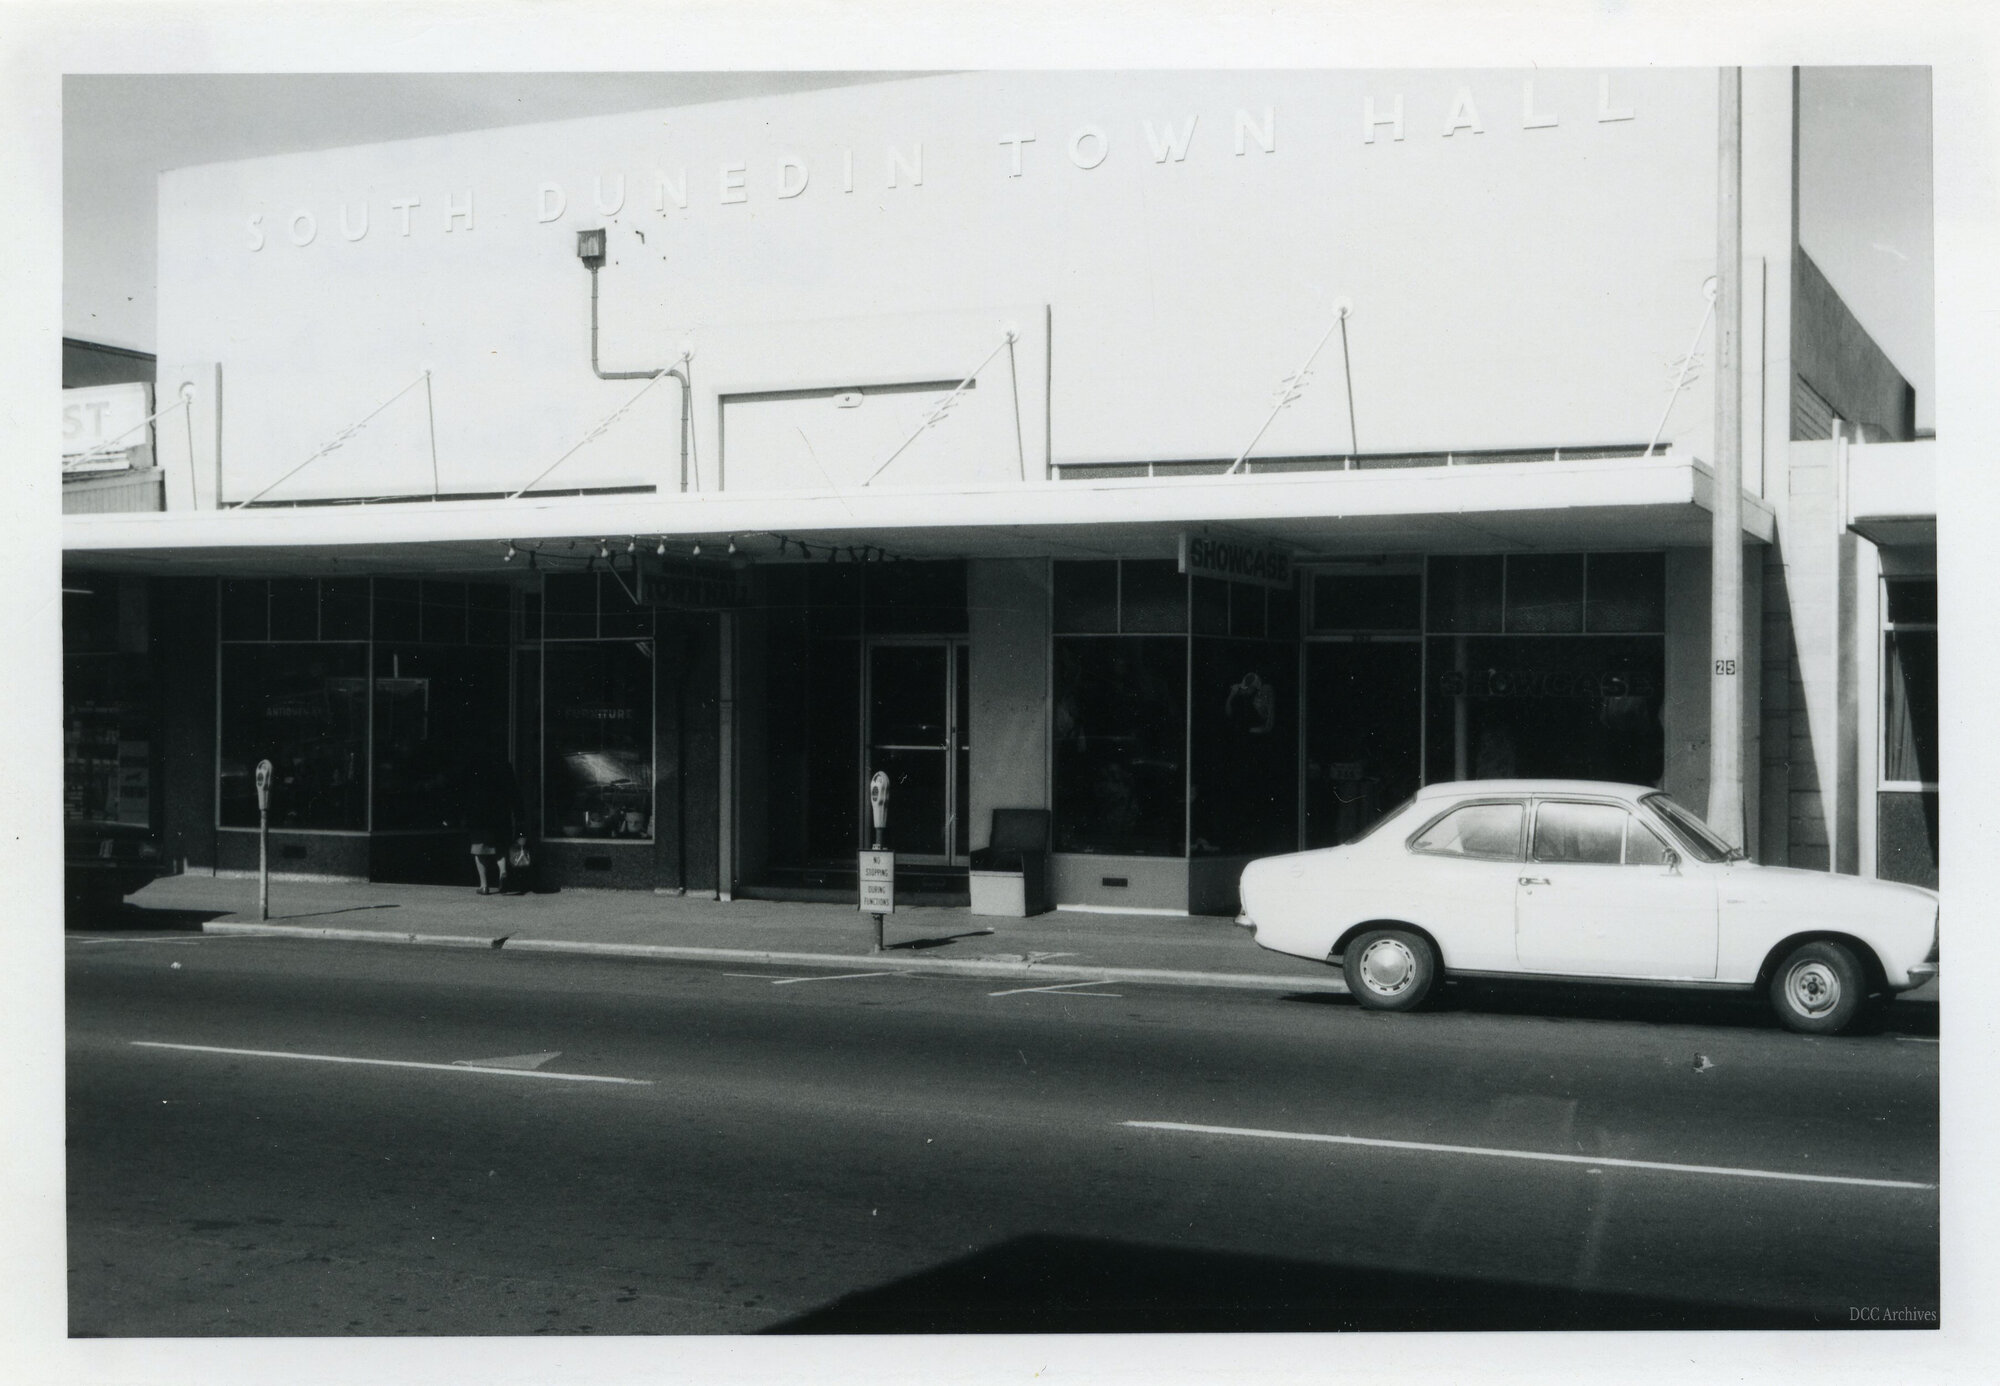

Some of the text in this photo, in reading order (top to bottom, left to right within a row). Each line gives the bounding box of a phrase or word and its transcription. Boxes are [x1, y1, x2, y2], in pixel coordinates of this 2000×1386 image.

[246, 72, 1636, 252] SOUTH DUNEDIN TOWN HALL
[1190, 537, 1290, 582] SHOWCASE
[1716, 660, 1735, 675] 25
[1439, 669, 1653, 698] SHOWCASE
[873, 857, 881, 865] NO
[865, 868, 889, 878] STOPPING
[868, 886, 886, 895] DURING
